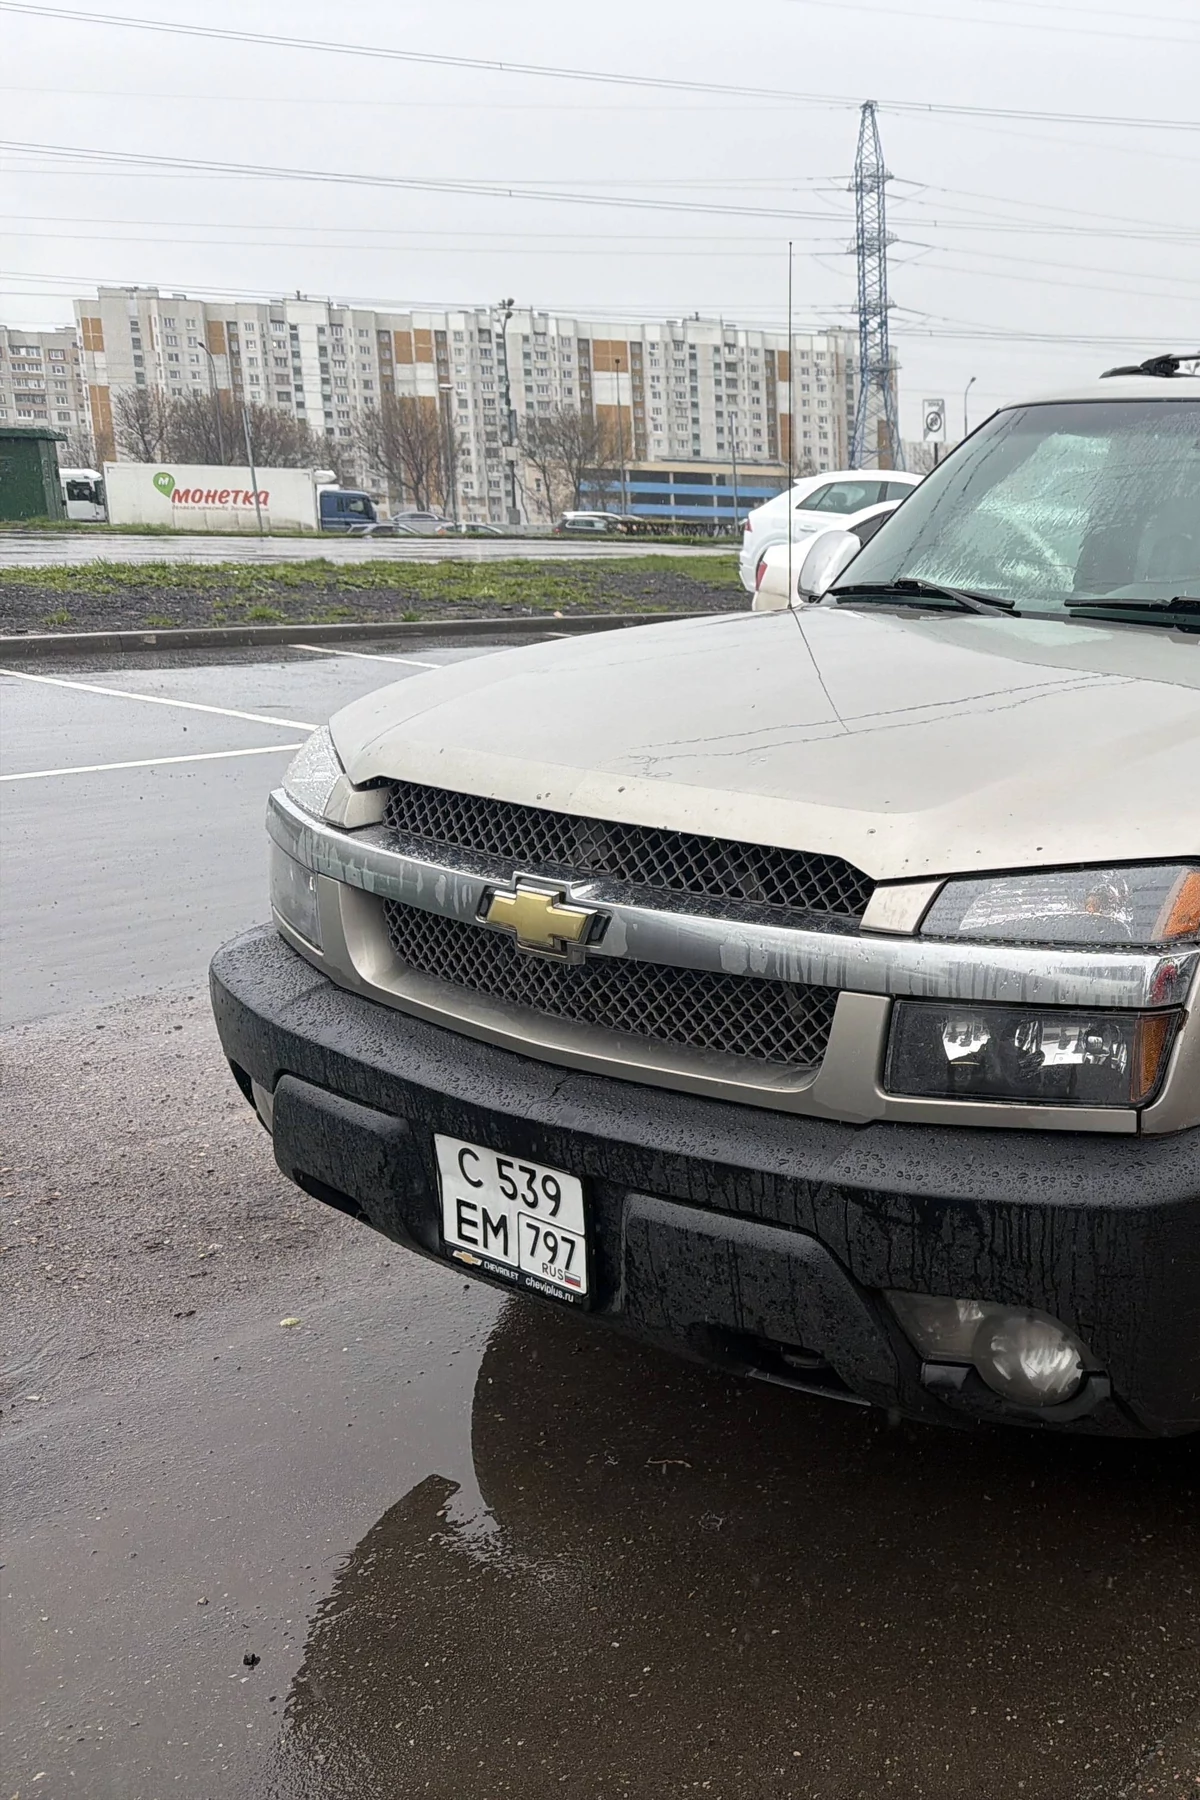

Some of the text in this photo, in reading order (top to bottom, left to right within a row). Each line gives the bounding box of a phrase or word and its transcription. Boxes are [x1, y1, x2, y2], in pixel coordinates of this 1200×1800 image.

[171, 488, 270, 506] монетка
[496, 1157, 561, 1217] 539
[526, 1222, 576, 1271] 797
[483, 1260, 519, 1281] CHEVROLET
[541, 1262, 564, 1281] RUS
[525, 1275, 574, 1303] cheviplus.ru
